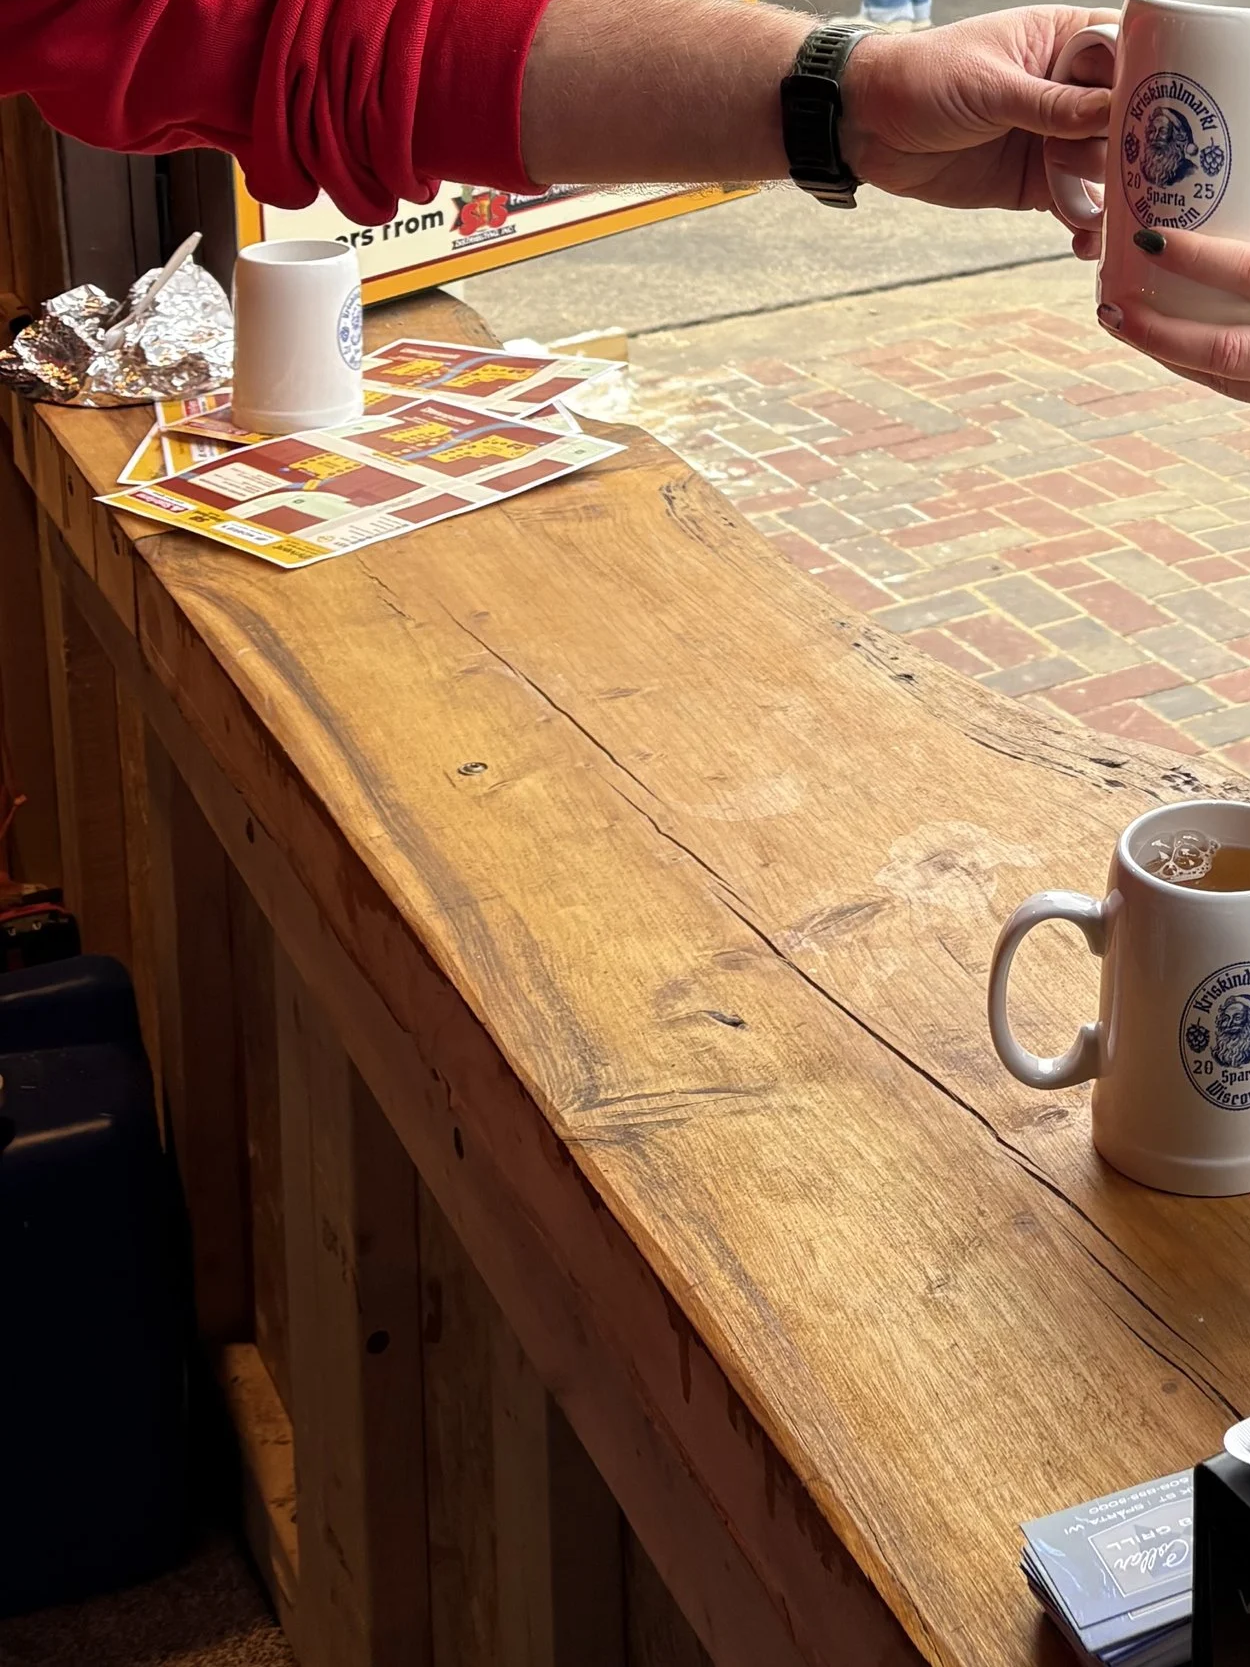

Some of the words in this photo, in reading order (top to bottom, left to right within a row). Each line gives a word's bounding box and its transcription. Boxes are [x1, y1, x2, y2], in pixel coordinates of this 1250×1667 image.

[1130, 80, 1218, 131] Kriskindlmarkt
[1127, 170, 1142, 190] 20
[1193, 182, 1215, 201] 25
[1147, 186, 1186, 209] Sparta
[1193, 1060, 1213, 1075] 20
[1088, 1503, 1145, 1526] SPARTA
[1063, 1523, 1085, 1536] WI
[1106, 1525, 1172, 1551] GRILL
[1113, 1538, 1190, 1574] Collar
